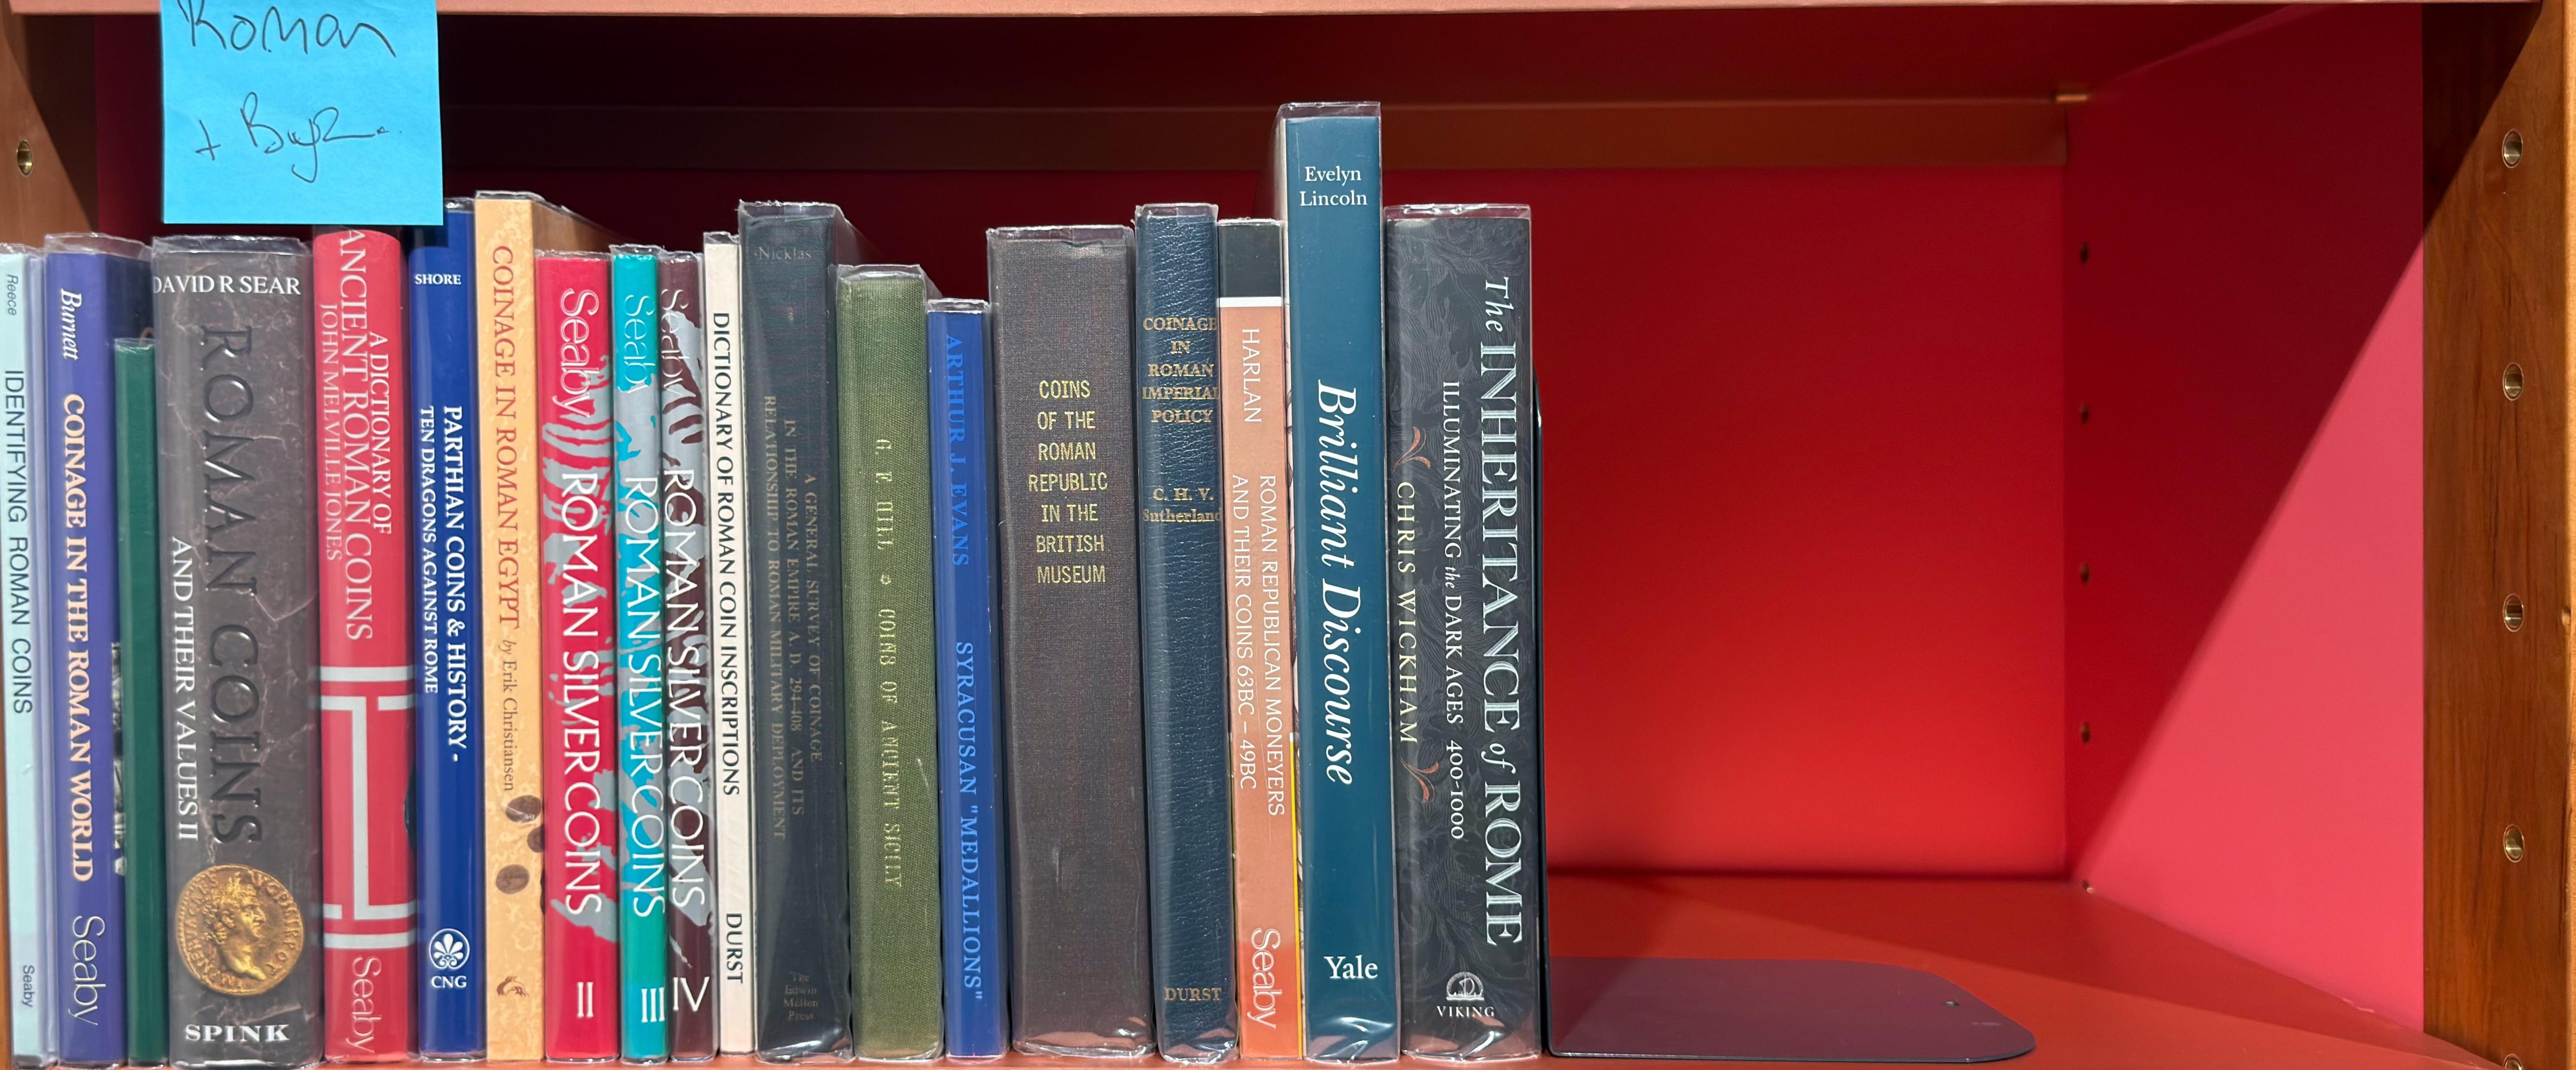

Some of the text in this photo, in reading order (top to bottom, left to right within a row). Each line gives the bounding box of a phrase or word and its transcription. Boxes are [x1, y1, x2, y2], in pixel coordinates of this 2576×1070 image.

[177, 0, 396, 58] Roman
[1299, 190, 1368, 207] Lincoln
[1304, 165, 1362, 188] Evelyn
[7, 274, 18, 316] Reece
[219, 275, 236, 293] R
[239, 276, 301, 295] SEAR
[415, 274, 462, 285] SHORE
[61, 288, 82, 361] Burnett
[552, 288, 600, 418] Seaby
[1142, 317, 1217, 331] COINAGE
[1170, 340, 1191, 354] IN
[1039, 379, 1091, 399] COINS
[1148, 364, 1215, 377] ROMAN
[1241, 328, 1262, 423] HARLAN
[319, 304, 342, 561] JOHN MELVILLE JONES
[340, 229, 372, 640] ANCIENT ROMAN COINS
[370, 331, 392, 534] A DICTIONARY OF
[784, 420, 796, 438] IN
[1037, 410, 1096, 430] OF THE
[1151, 409, 1213, 423] POLICY
[200, 326, 258, 594] ROMAN
[785, 445, 797, 479] THE
[946, 334, 970, 567] ARTHUR J. EVANS
[1028, 472, 1108, 492] REPUBLIC
[1038, 442, 1096, 460] ROMAN
[1443, 381, 1462, 559] ILLUMINATING
[492, 245, 521, 791] COINAGE IN ROMAN EGYPT by Erik Christiansen
[785, 488, 799, 551] ROMAN
[1041, 503, 1099, 523] IN THE
[1152, 487, 1214, 501] C. H. V.
[5, 370, 33, 715] IDENTIFYING ROMAN COINS
[420, 406, 438, 693] TEN DRAGONS AGAINST ROME
[713, 313, 740, 796] DICTIONARY OF ROMAN COIN INSCRIPTIONS
[1036, 534, 1105, 554] BRITISH
[1037, 564, 1106, 584] MUSEUM
[444, 406, 467, 749] PARTHIAN COINS & HISTORY
[787, 558, 801, 622] EMPIRE
[1318, 379, 1362, 785] Brilliant Discourse
[1445, 566, 1461, 589] the
[63, 393, 93, 882] COINAGE IN THE ROMAN WORLD
[764, 396, 786, 840] RELATIONSHIP TO ROMAN MILITARY DEPLOYMENT
[804, 473, 823, 762] A GENERAL SURVEY OF COINAGE
[1232, 474, 1256, 789] AND THEIR COINS 63BC 49BC
[1397, 481, 1418, 744] CHRIS WICKHAM
[1445, 595, 1463, 660] DARK
[1480, 276, 1523, 947] The INHERITANCE of ROME
[1260, 476, 1285, 816] ROMAN REPUBLICAN MONEYERS
[172, 536, 199, 842] AND THEIR VALUES II
[561, 473, 602, 916] ROMAN SILVER COINS
[624, 477, 665, 917] ROMAN SILVER COINS
[664, 469, 705, 908] ROMAN SILVER COINS
[1446, 667, 1464, 724] AGES
[209, 624, 263, 845] COINS
[792, 746, 804, 782] AND
[793, 789, 805, 815] ITS
[956, 641, 983, 999] SYRACUSAN "MEDALLIONS"
[68, 915, 105, 1025] Seaby
[726, 913, 743, 984] DURST
[1246, 927, 1283, 1029] Seaby
[1323, 955, 1378, 979] Yale
[22, 965, 35, 1007] Seaby
[346, 955, 382, 1053] Seaby
[431, 976, 467, 988] CNG
[577, 981, 594, 1018] II
[641, 987, 665, 1023] III
[673, 976, 710, 1012] IV
[1163, 987, 1222, 1002] DURST
[1436, 1006, 1495, 1017] VIKING
[184, 1023, 290, 1042] SPINK
[788, 1010, 814, 1020] Press
